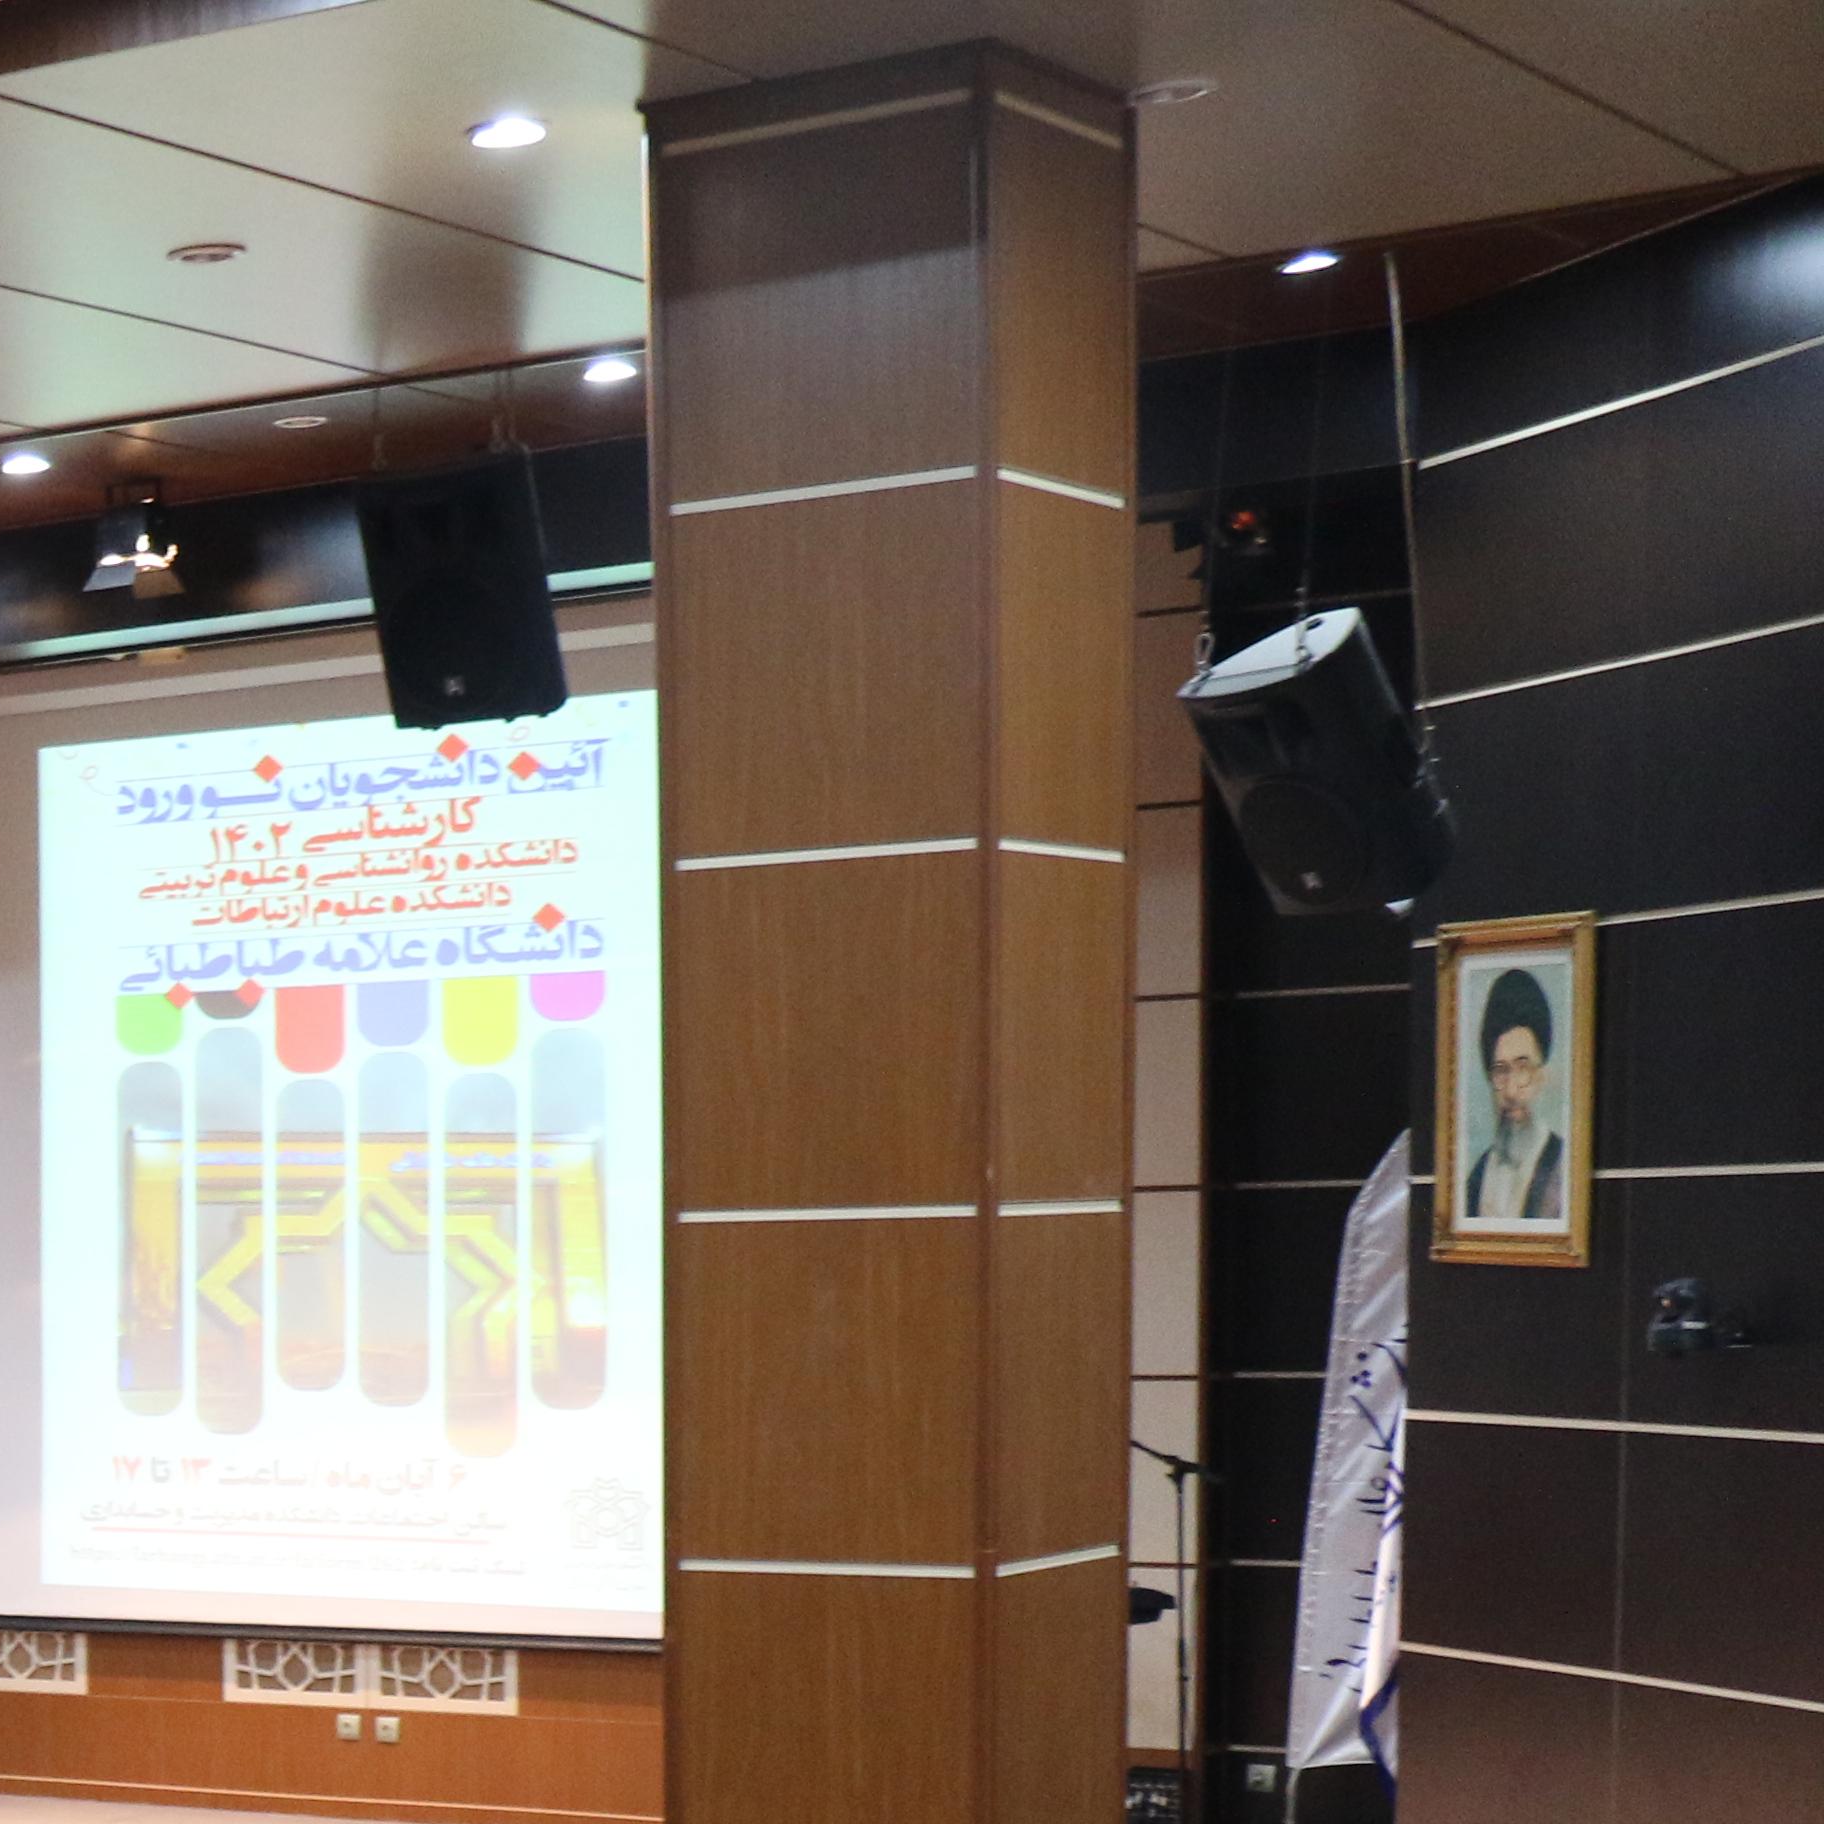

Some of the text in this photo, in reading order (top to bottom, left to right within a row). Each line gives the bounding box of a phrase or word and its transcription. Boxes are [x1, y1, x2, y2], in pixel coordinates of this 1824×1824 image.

[289, 735, 500, 811] دانشجویان
[210, 796, 482, 863] کارشناسی ۱۴۰۲
[313, 848, 449, 887] روانشناسی
[455, 839, 579, 871] دانشکده
[138, 864, 216, 900] تربیتی
[220, 859, 290, 897] علوم
[191, 881, 512, 929] دانشکده علوم ارتباطات
[312, 931, 428, 973] علامه
[435, 906, 604, 966] دانشگاه
